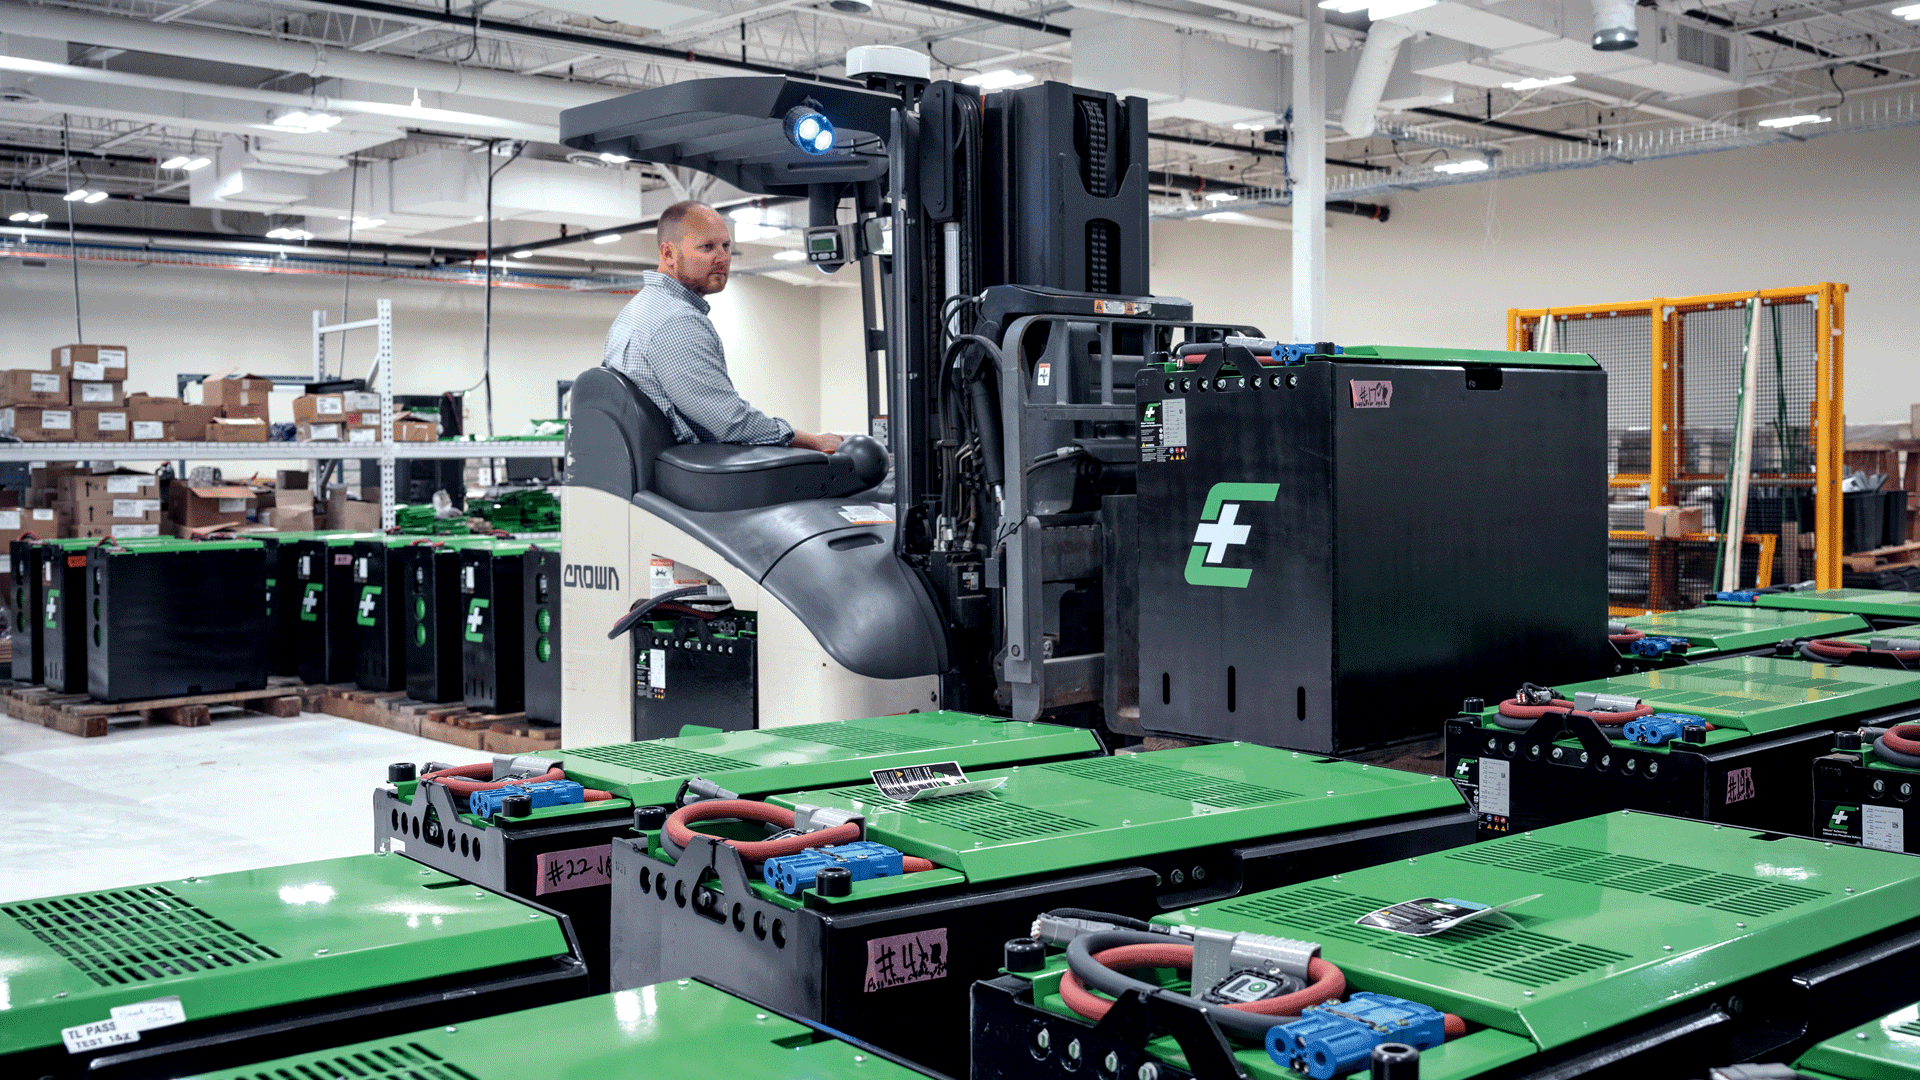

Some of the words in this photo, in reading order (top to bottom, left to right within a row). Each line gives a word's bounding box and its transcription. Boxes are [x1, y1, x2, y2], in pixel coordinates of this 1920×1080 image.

[564, 563, 620, 591] CROWN
[546, 859, 593, 887] #22
[68, 1030, 83, 1040] TL
[86, 1021, 117, 1036] PASS
[75, 1037, 103, 1049] TEST
